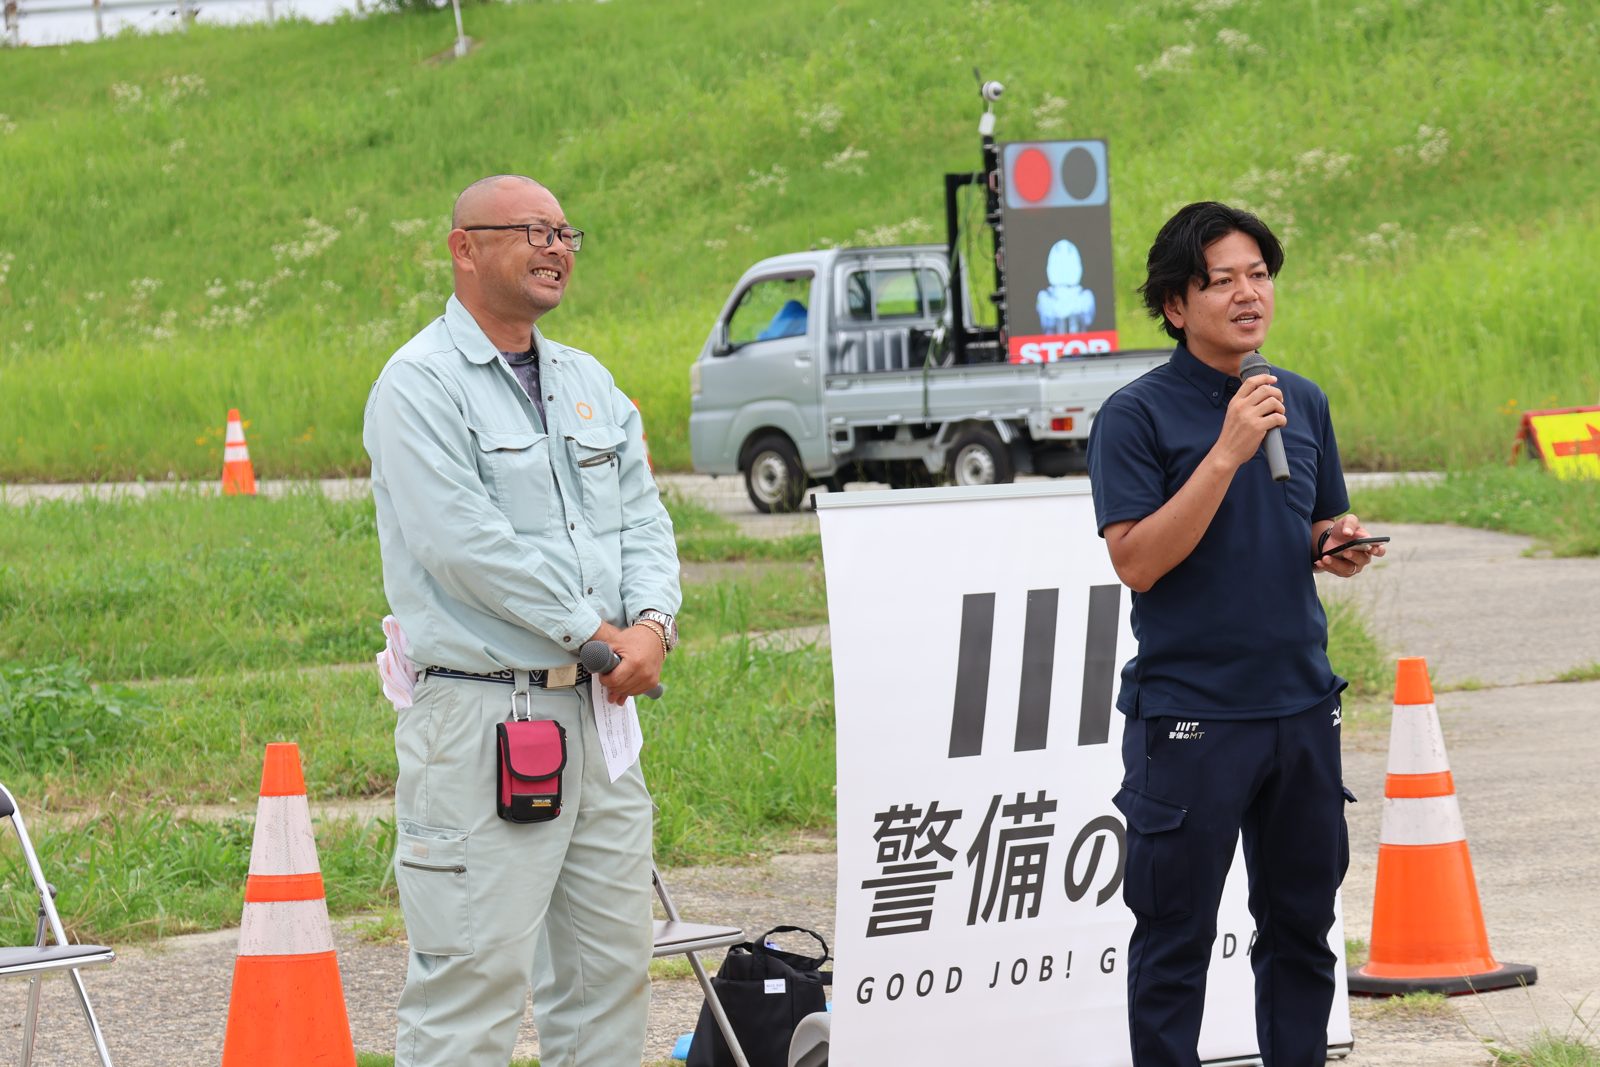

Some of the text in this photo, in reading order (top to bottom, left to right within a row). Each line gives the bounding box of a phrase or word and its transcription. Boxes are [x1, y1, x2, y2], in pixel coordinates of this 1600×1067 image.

[861, 790, 1127, 938] 警備の
[856, 966, 963, 1005] GOOD
[988, 950, 1074, 988] JOB!
